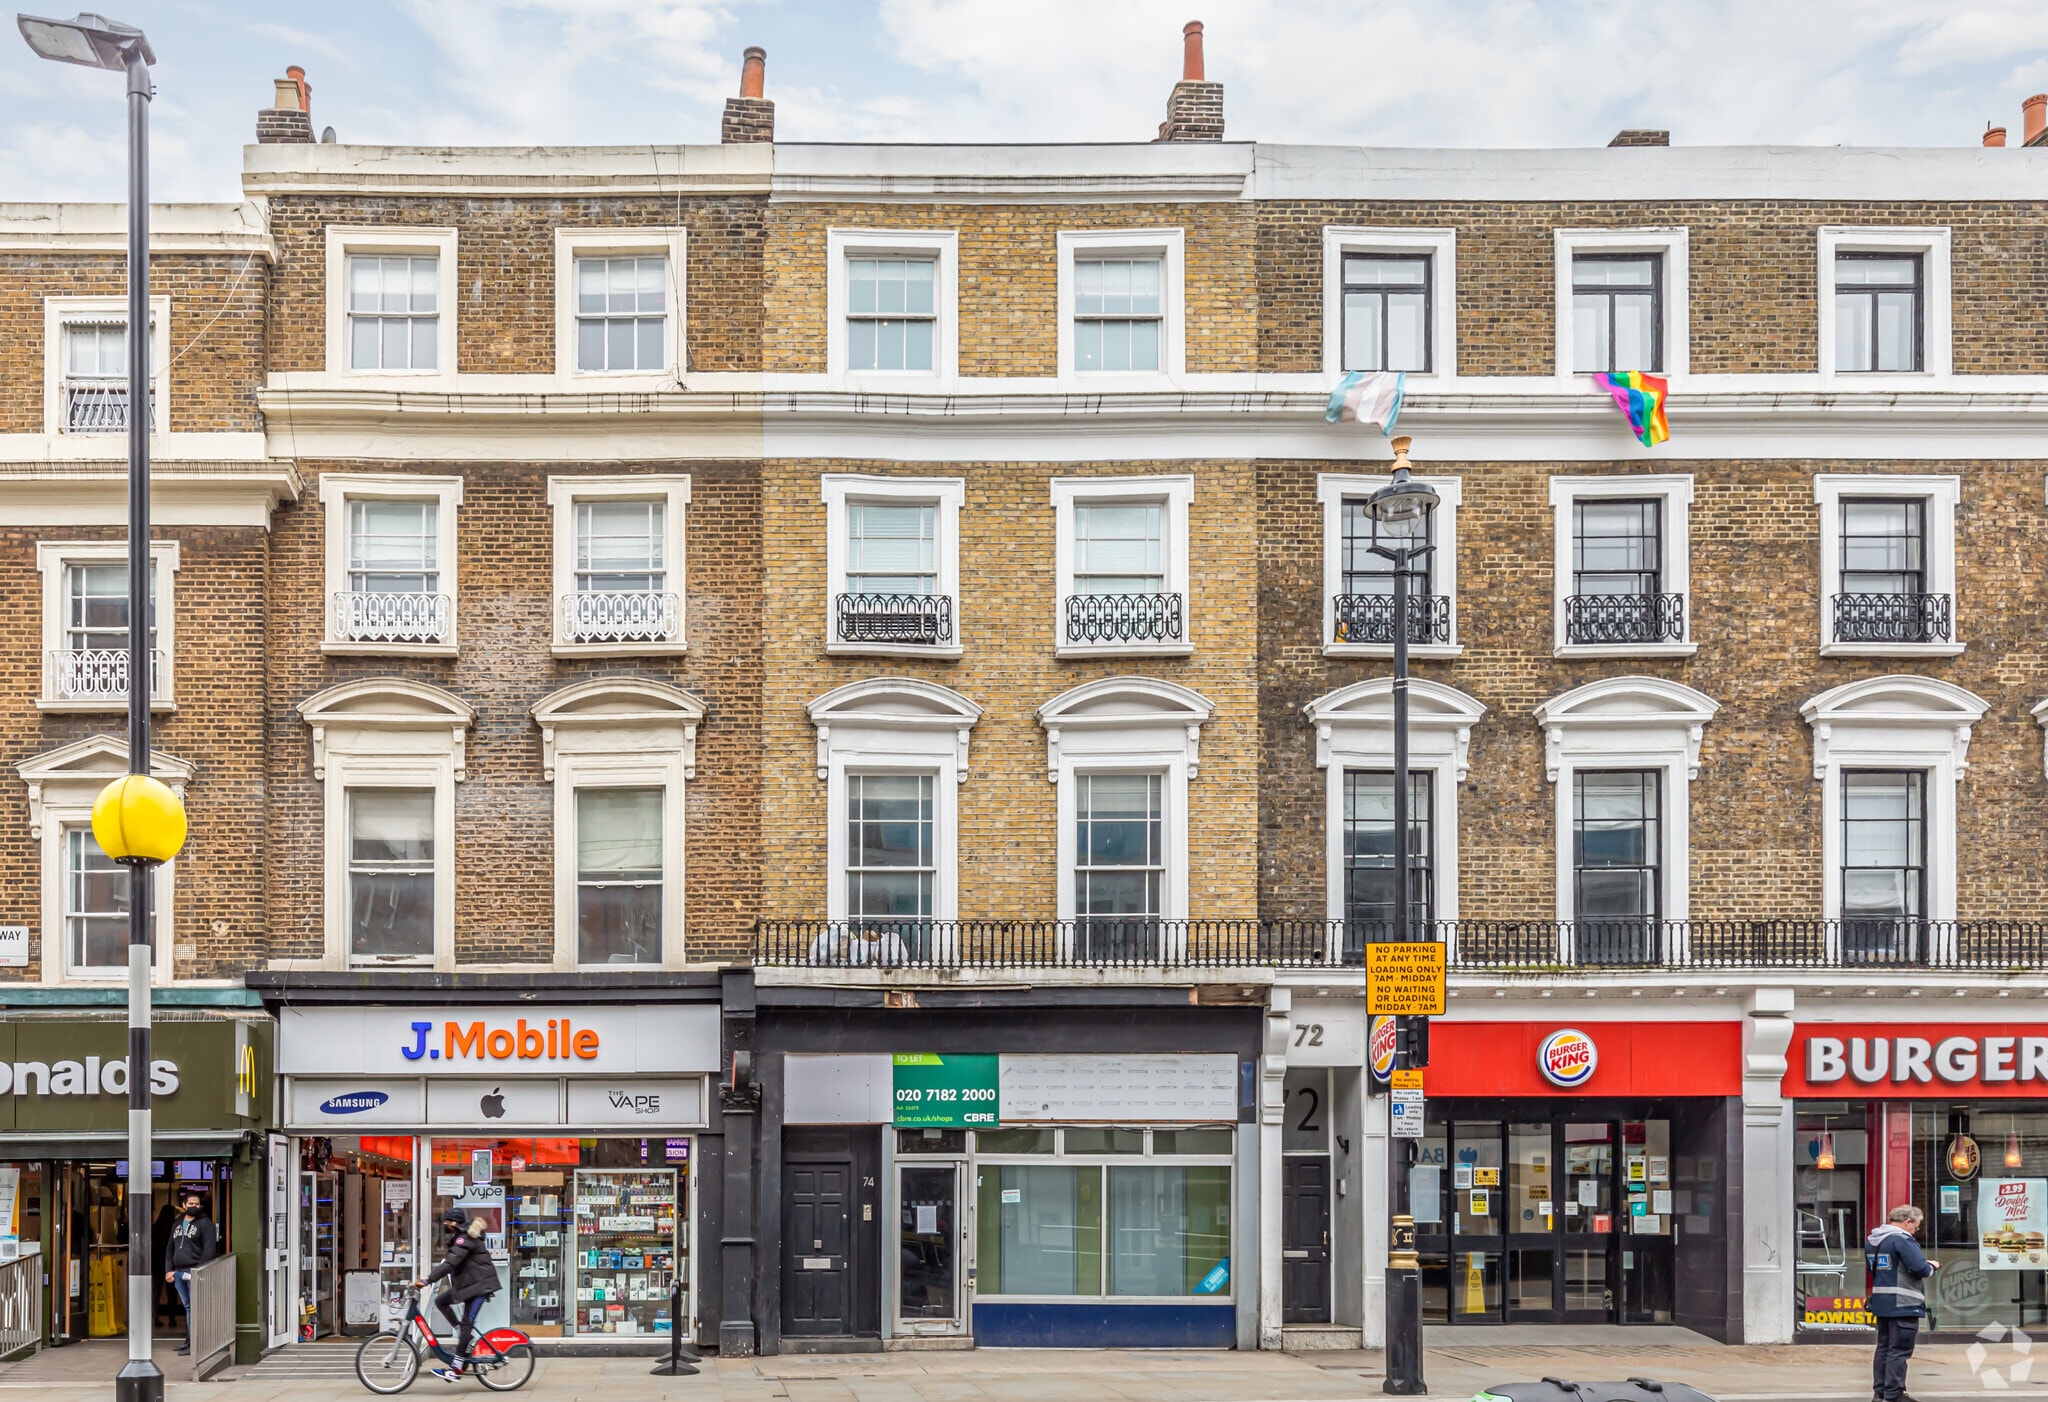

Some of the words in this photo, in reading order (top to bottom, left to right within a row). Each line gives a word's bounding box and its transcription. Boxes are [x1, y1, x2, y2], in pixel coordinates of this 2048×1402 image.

[1294, 1024, 1324, 1047] 72
[1370, 1020, 1395, 1051] BURGER
[1370, 1031, 1396, 1068] KING
[1549, 1042, 1588, 1059] BURGER
[1550, 1050, 1590, 1072] KING
[1806, 1036, 2048, 1083] BURGER
[608, 1095, 660, 1108] VAPE
[896, 1089, 921, 1101] 020
[926, 1089, 957, 1101] 7182
[961, 1089, 996, 1101] 2000
[328, 1098, 380, 1108] SAMSUNG
[896, 1115, 953, 1123] cbre.co.uk/shops
[963, 1113, 995, 1122] CBRE
[863, 1176, 874, 1187] 74
[469, 1186, 503, 1199] vype
[1995, 1195, 2030, 1208] Double
[2005, 1205, 2031, 1217] Melt
[1942, 1268, 1988, 1290] BURGER
[1944, 1277, 1990, 1304] KING
